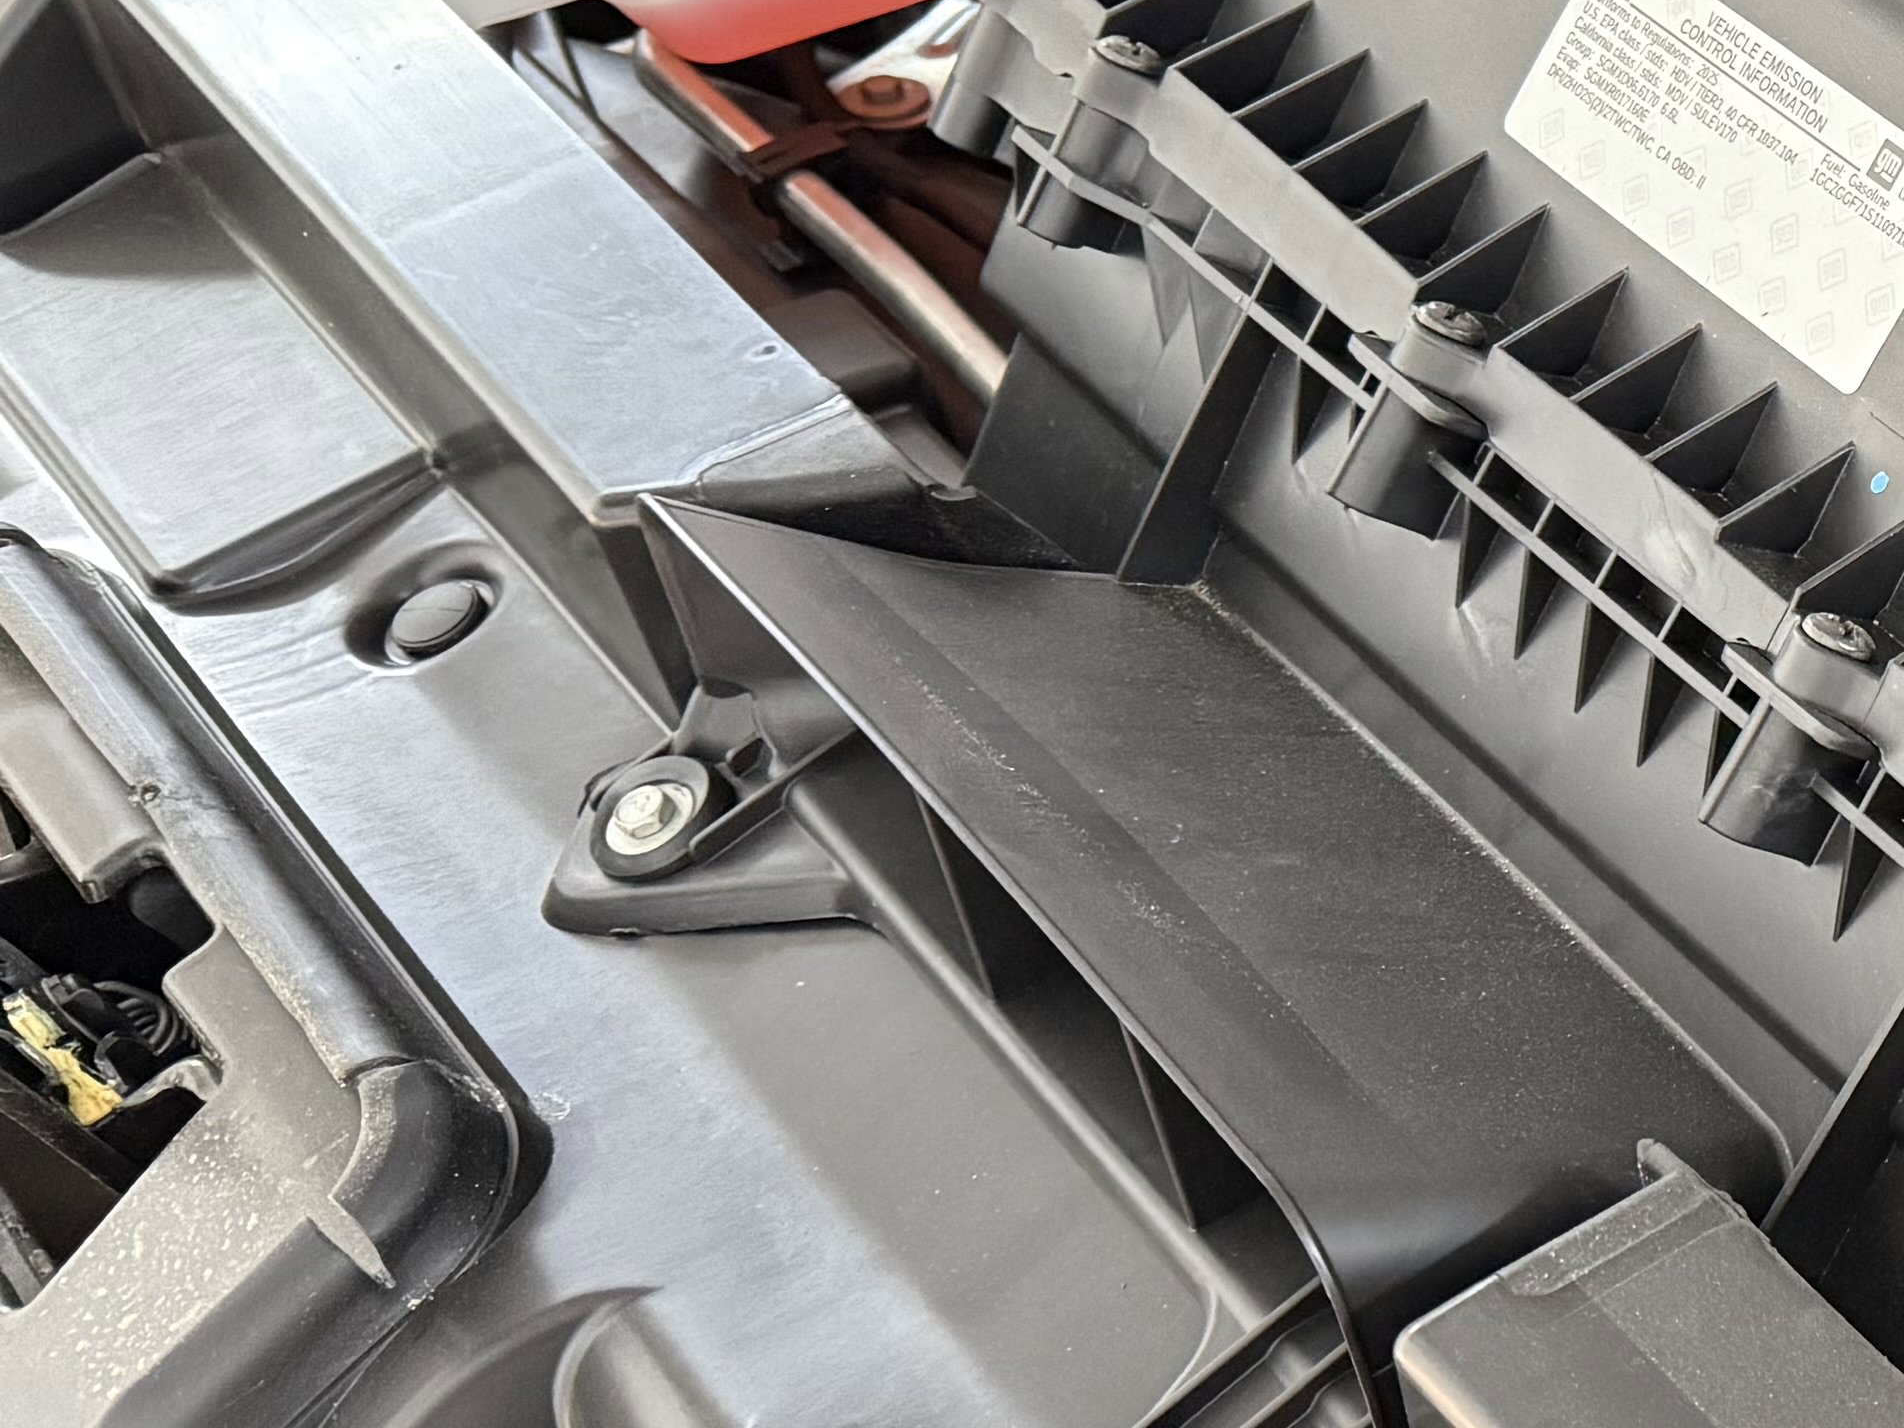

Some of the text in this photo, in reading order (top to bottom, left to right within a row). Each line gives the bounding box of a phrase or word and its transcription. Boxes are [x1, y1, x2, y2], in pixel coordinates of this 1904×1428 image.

[1554, 46, 1583, 75] Evap:
[1562, 30, 1596, 63] Group:
[1572, 15, 1615, 54] California
[1611, 44, 1638, 70] class
[1663, 82, 1689, 108] MDV
[1689, 101, 1738, 145] SULEV170
[1581, 0, 1603, 22] U.S.
[1599, 13, 1621, 36] EPA
[1616, 26, 1644, 52] class
[1669, 64, 1693, 88] HDV
[1693, 82, 1727, 115] TIER3,
[1723, 103, 1738, 121] 40
[1735, 112, 1759, 137] CFR
[1629, 15, 1643, 31] to
[1638, 21, 1696, 71] Regulations:
[1695, 62, 1721, 88] 2025
[1678, 17, 1828, 134] CONTROL INFORMATION
[1704, 10, 1824, 104] VEHICLE EMISSION
[1654, 143, 1672, 164] CA
[1819, 152, 1892, 212] Fuel: Gasoline
